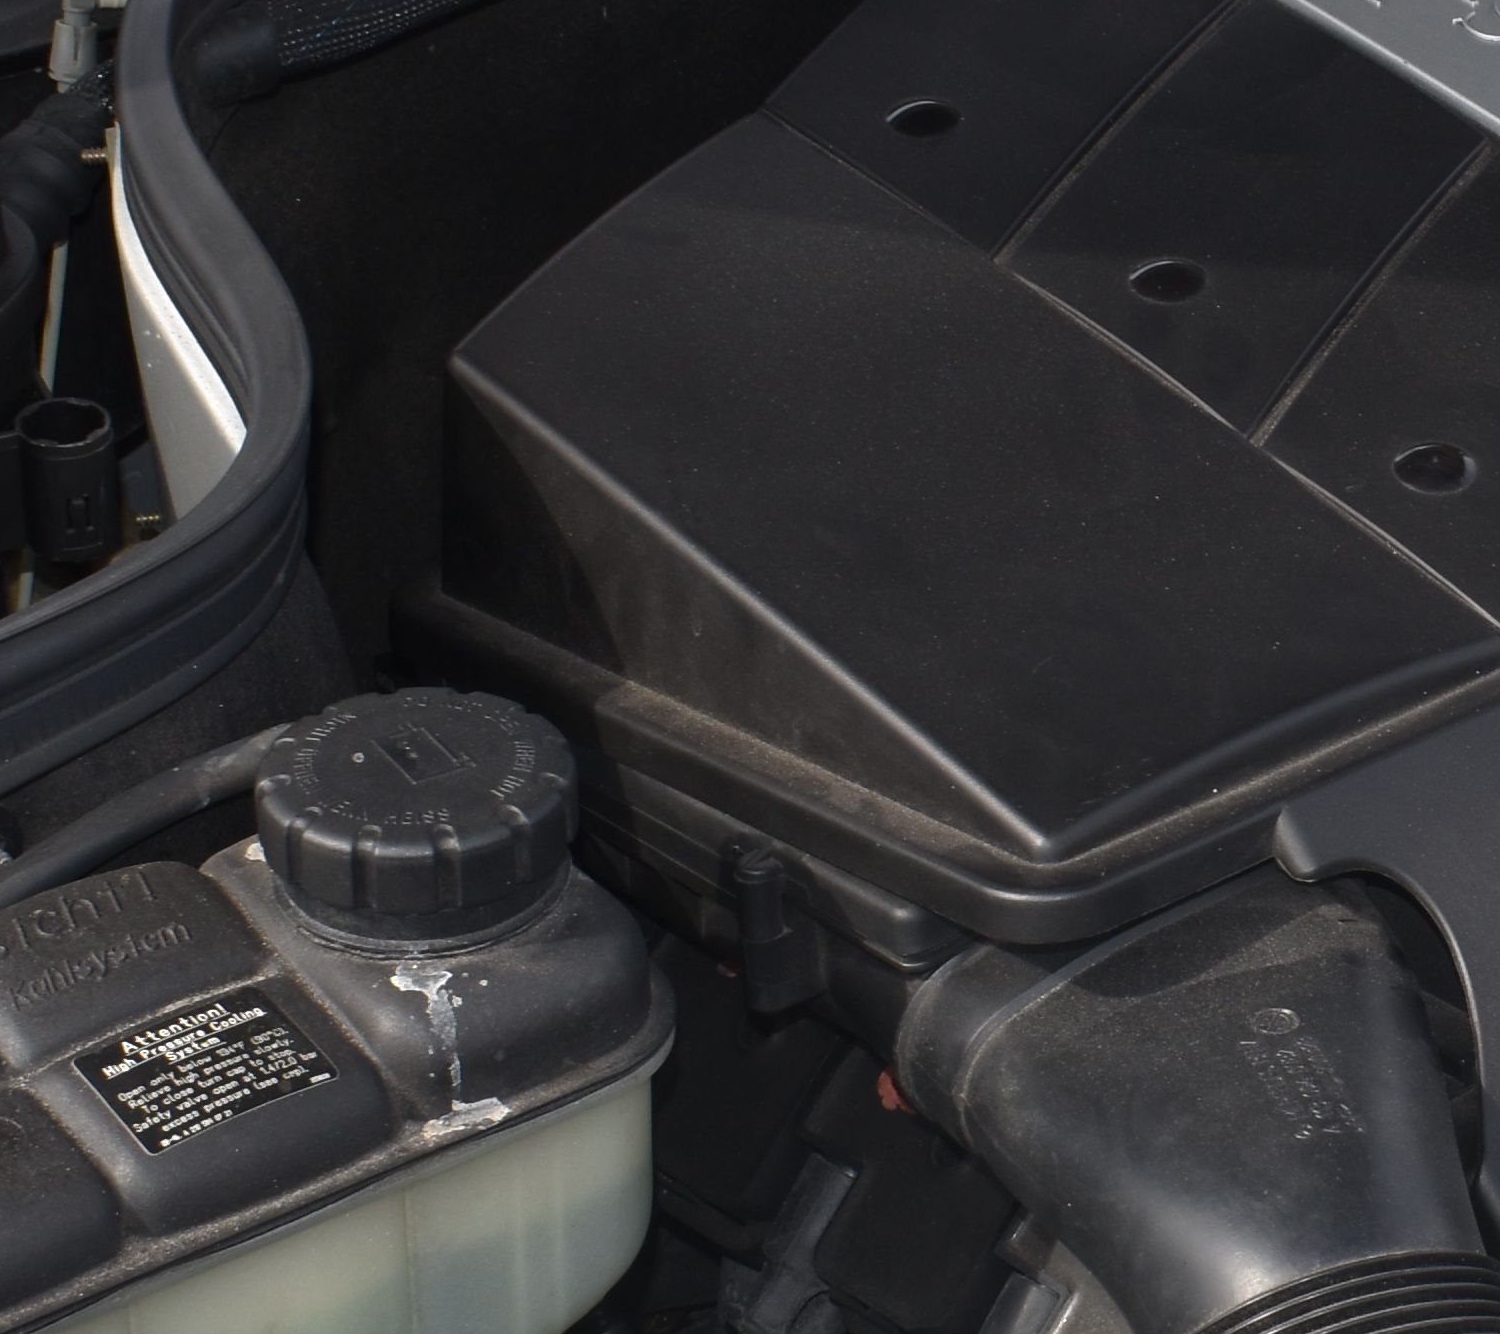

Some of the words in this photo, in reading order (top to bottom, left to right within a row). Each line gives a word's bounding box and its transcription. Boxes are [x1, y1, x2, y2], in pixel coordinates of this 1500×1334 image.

[100, 1056, 137, 1077] High
[139, 1029, 207, 1060] Pressure
[208, 1005, 263, 1031] Cooling
[117, 1003, 227, 1052] Attention!
[164, 1035, 221, 1060] System
